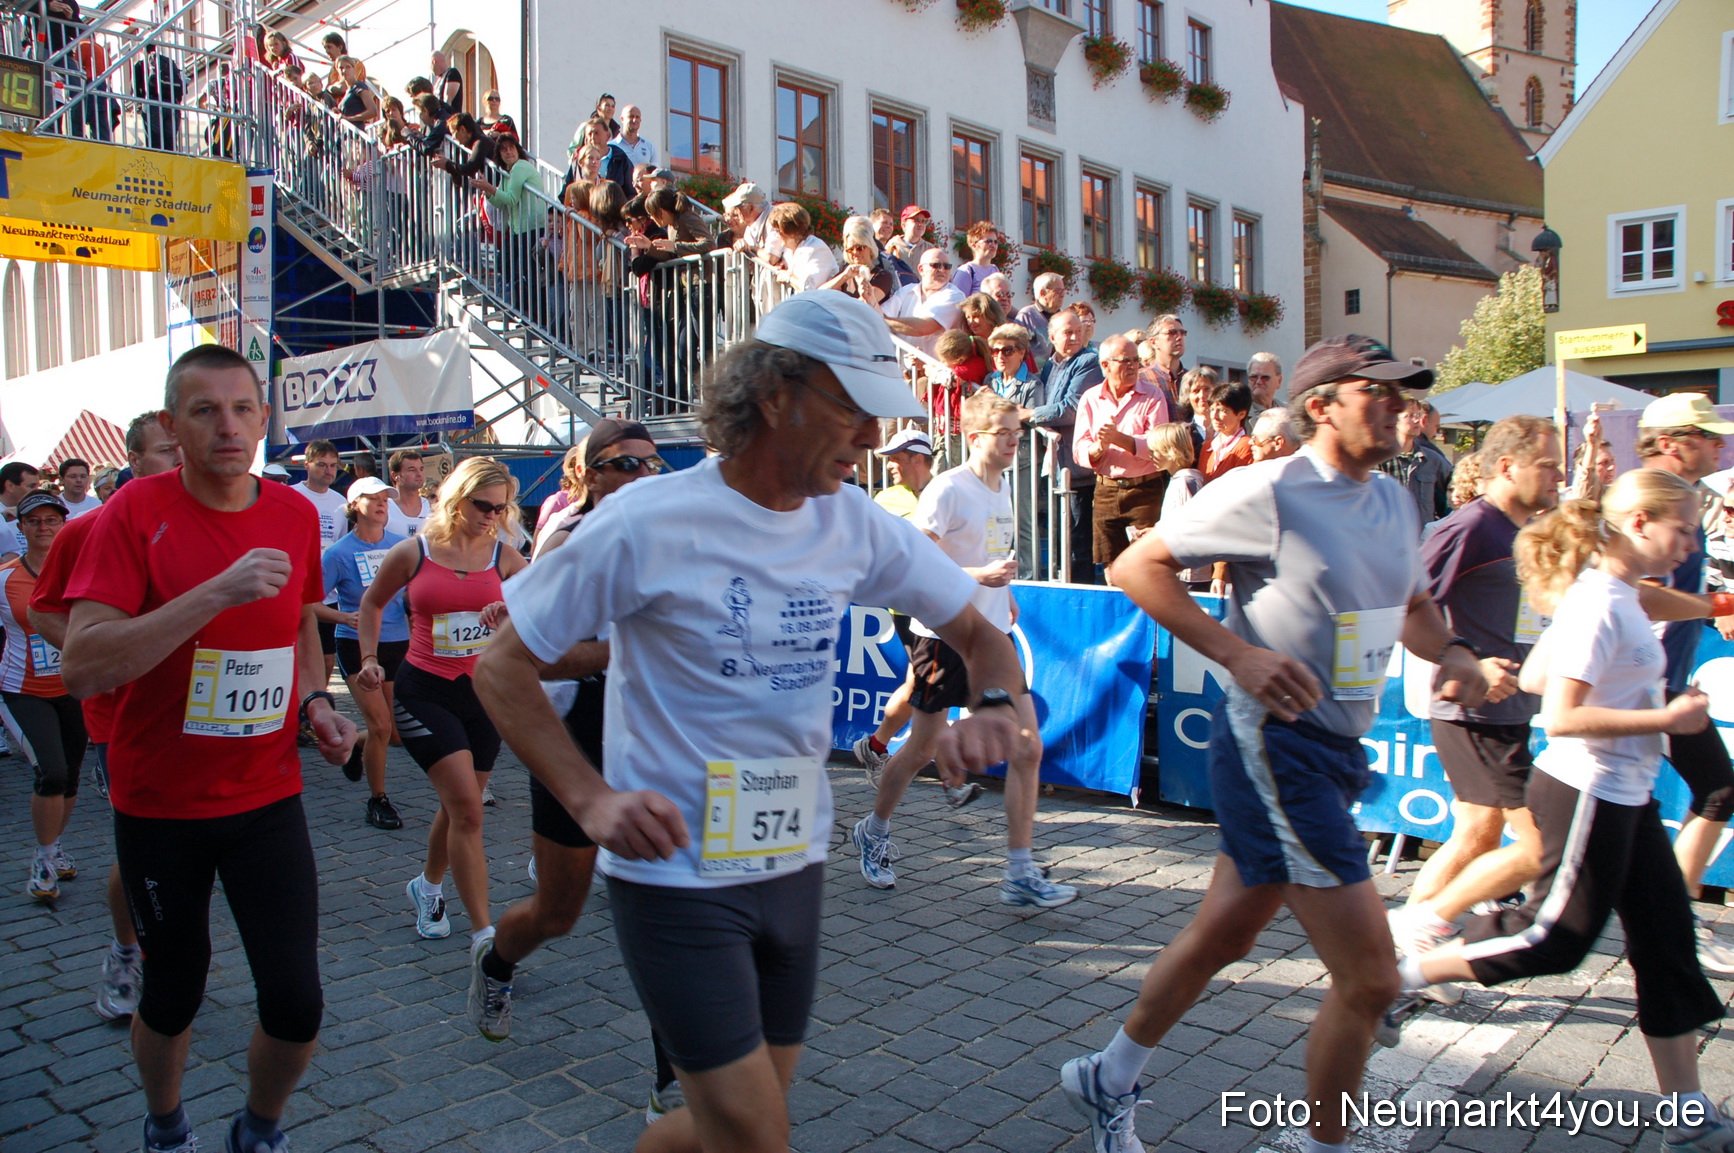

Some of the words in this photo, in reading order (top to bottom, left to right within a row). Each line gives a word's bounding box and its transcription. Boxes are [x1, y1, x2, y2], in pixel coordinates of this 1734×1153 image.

[71, 186, 151, 207] Neumarkter
[154, 197, 213, 214] Stadtlauf
[1558, 332, 1628, 345] Startnummern-
[1573, 344, 1613, 355] ausgabe
[283, 358, 378, 412] BOCK
[452, 626, 491, 642] 1224
[225, 658, 263, 676] Peter
[195, 682, 204, 694] C
[225, 686, 284, 713] 1010
[741, 767, 799, 796] Stephan
[751, 807, 801, 842] 574
